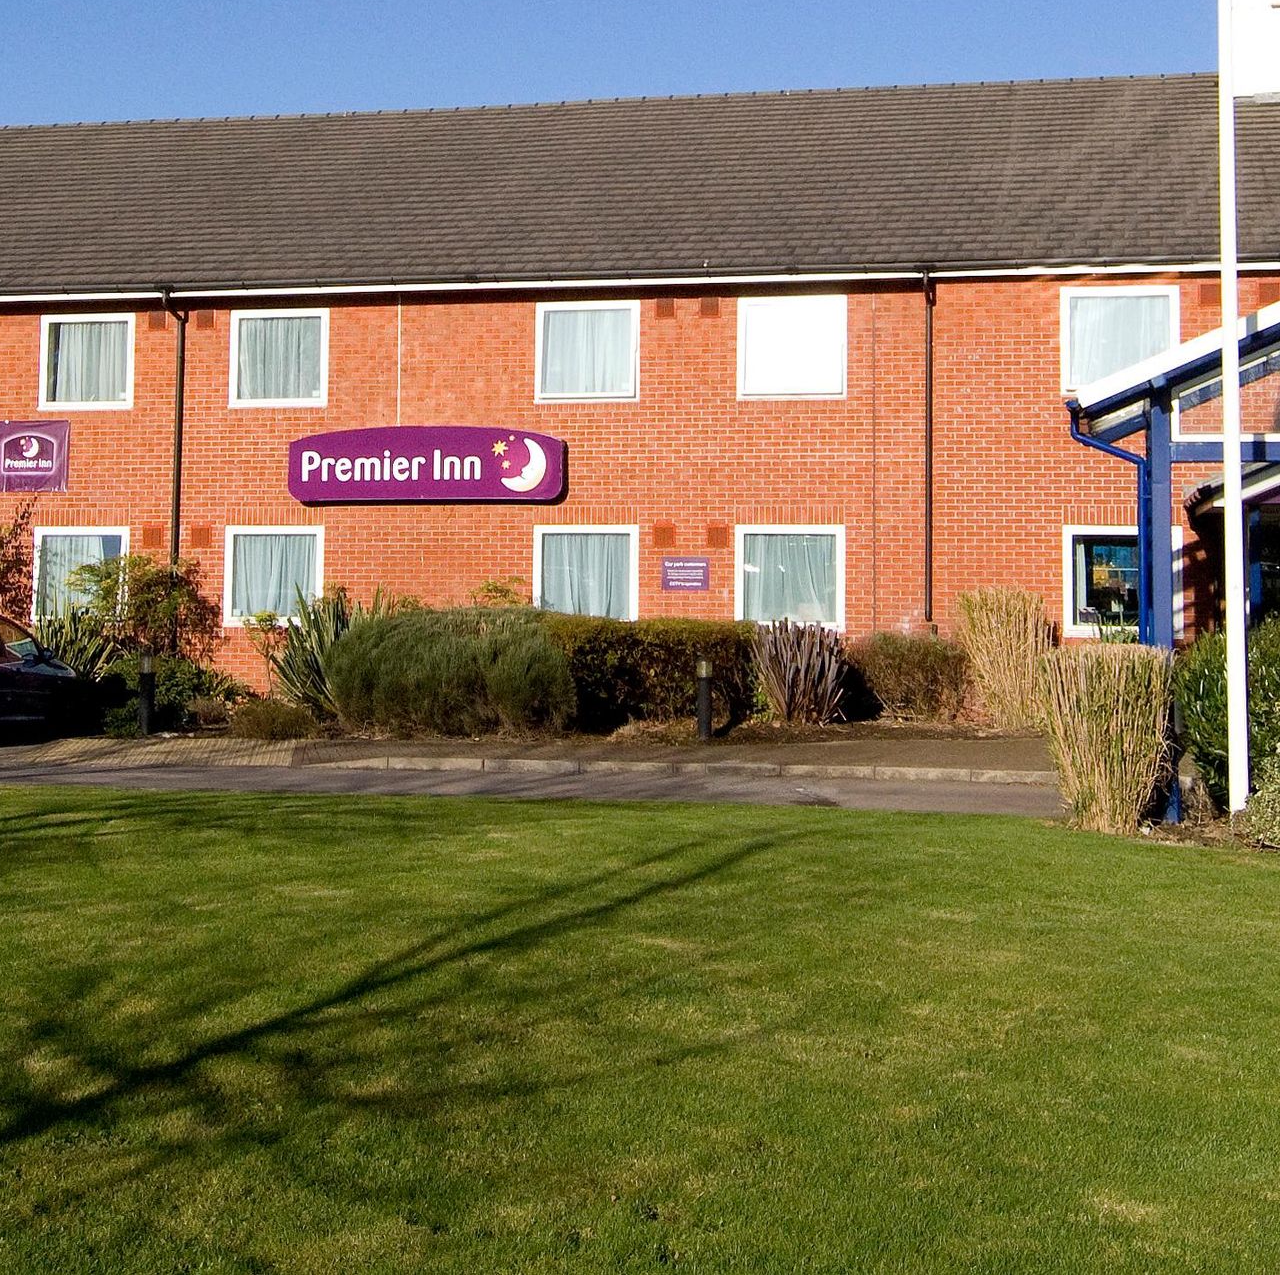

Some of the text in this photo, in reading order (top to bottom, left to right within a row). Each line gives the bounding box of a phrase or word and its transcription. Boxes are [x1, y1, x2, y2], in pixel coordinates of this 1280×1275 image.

[4, 458, 52, 469] Premier Inn
[301, 449, 482, 482] Premier Inn
